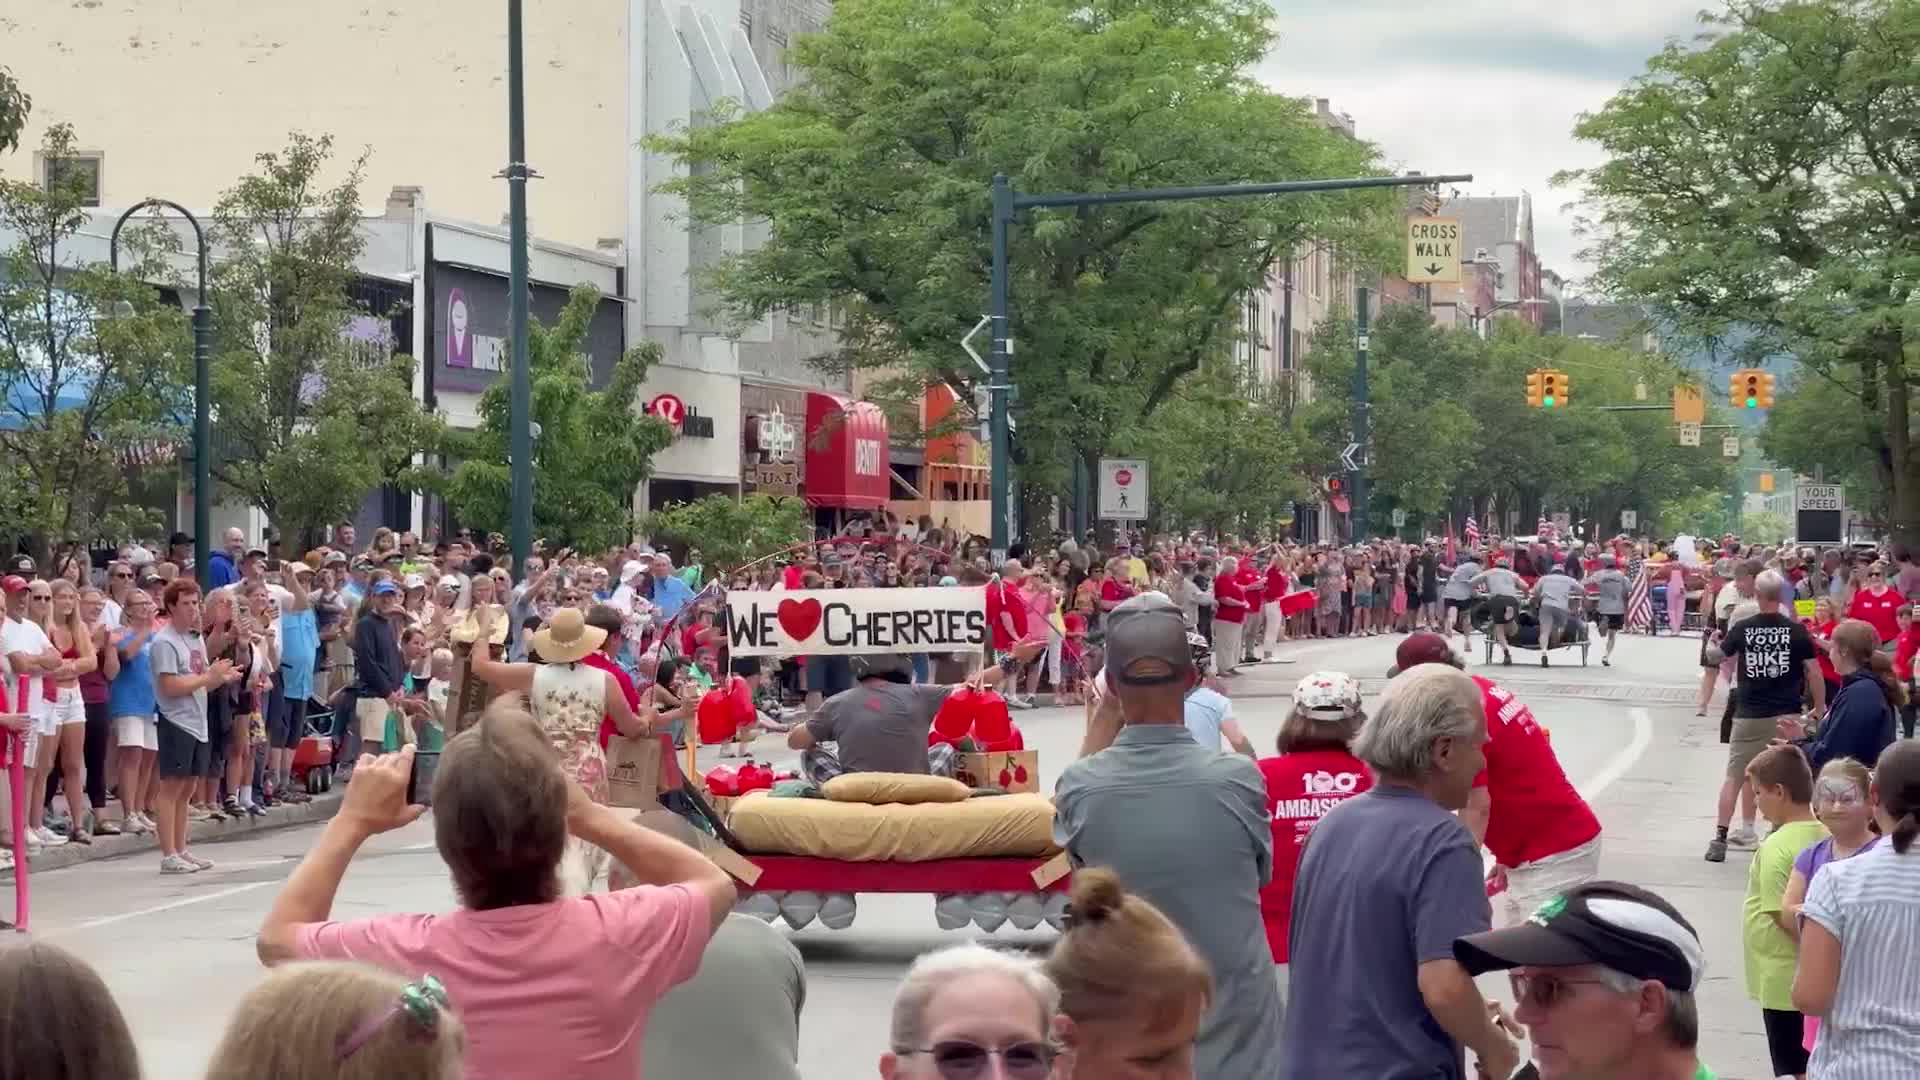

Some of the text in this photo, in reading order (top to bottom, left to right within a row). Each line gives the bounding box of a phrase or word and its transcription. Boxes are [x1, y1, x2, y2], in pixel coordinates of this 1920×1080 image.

[1411, 224, 1457, 239] CROSS
[1415, 242, 1452, 257] WALK
[1805, 487, 1835, 497] YOUR
[1801, 499, 1837, 509] SPEED
[822, 602, 985, 648] CHERRIES
[1744, 627, 1791, 636] SUPPORT
[1745, 634, 1790, 645] YOUR
[1745, 644, 1790, 652] LOCAL
[1745, 651, 1790, 666] BIKE
[1746, 665, 1790, 678] SHOP
